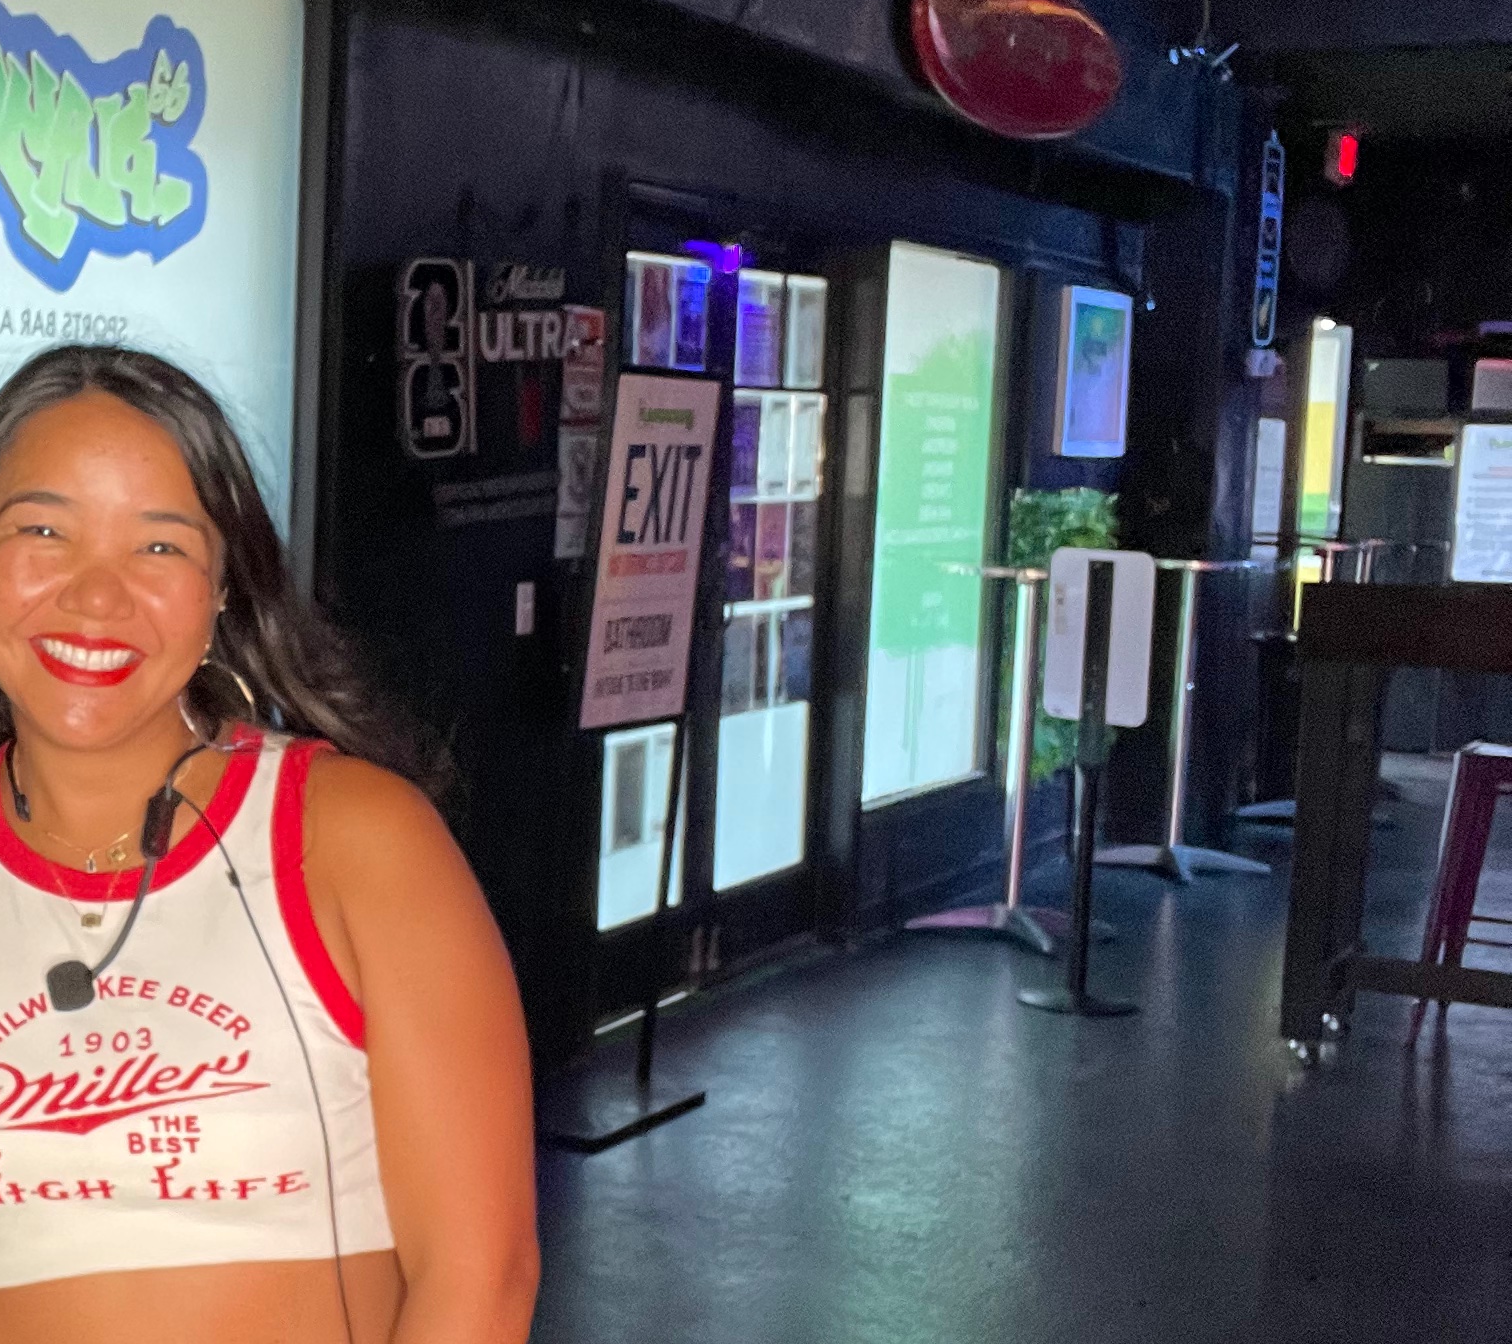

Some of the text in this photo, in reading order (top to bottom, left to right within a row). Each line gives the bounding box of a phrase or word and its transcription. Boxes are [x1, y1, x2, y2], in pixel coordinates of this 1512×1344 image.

[616, 444, 702, 545] EXIT
[166, 984, 252, 1040] BEER
[59, 1027, 154, 1057] 1903
[148, 1115, 202, 1133] THE
